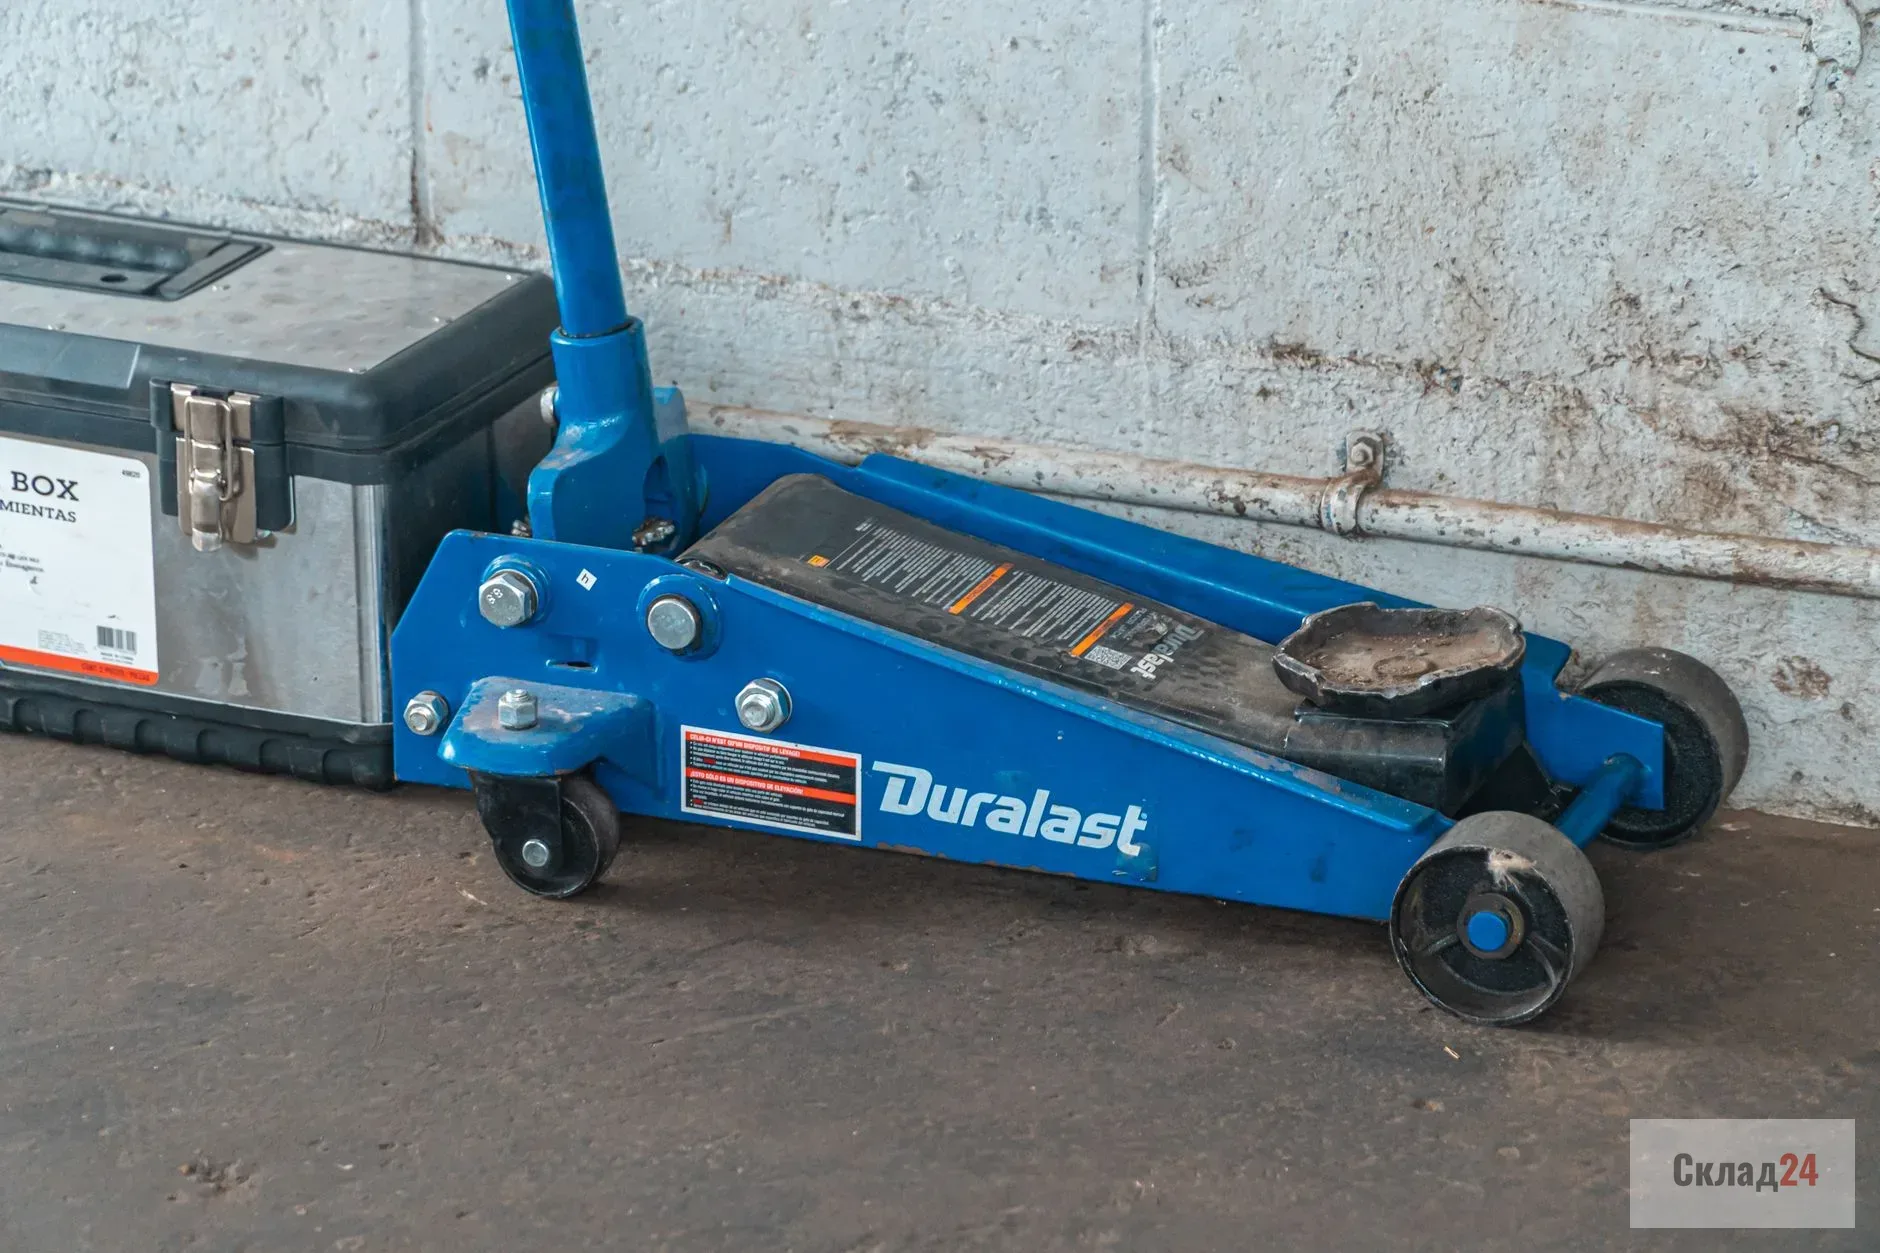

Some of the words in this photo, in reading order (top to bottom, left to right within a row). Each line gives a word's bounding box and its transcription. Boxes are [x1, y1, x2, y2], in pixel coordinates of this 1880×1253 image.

[11, 471, 79, 501] BOX
[1130, 623, 1205, 680] Duralast
[872, 760, 1148, 857] Duralast
